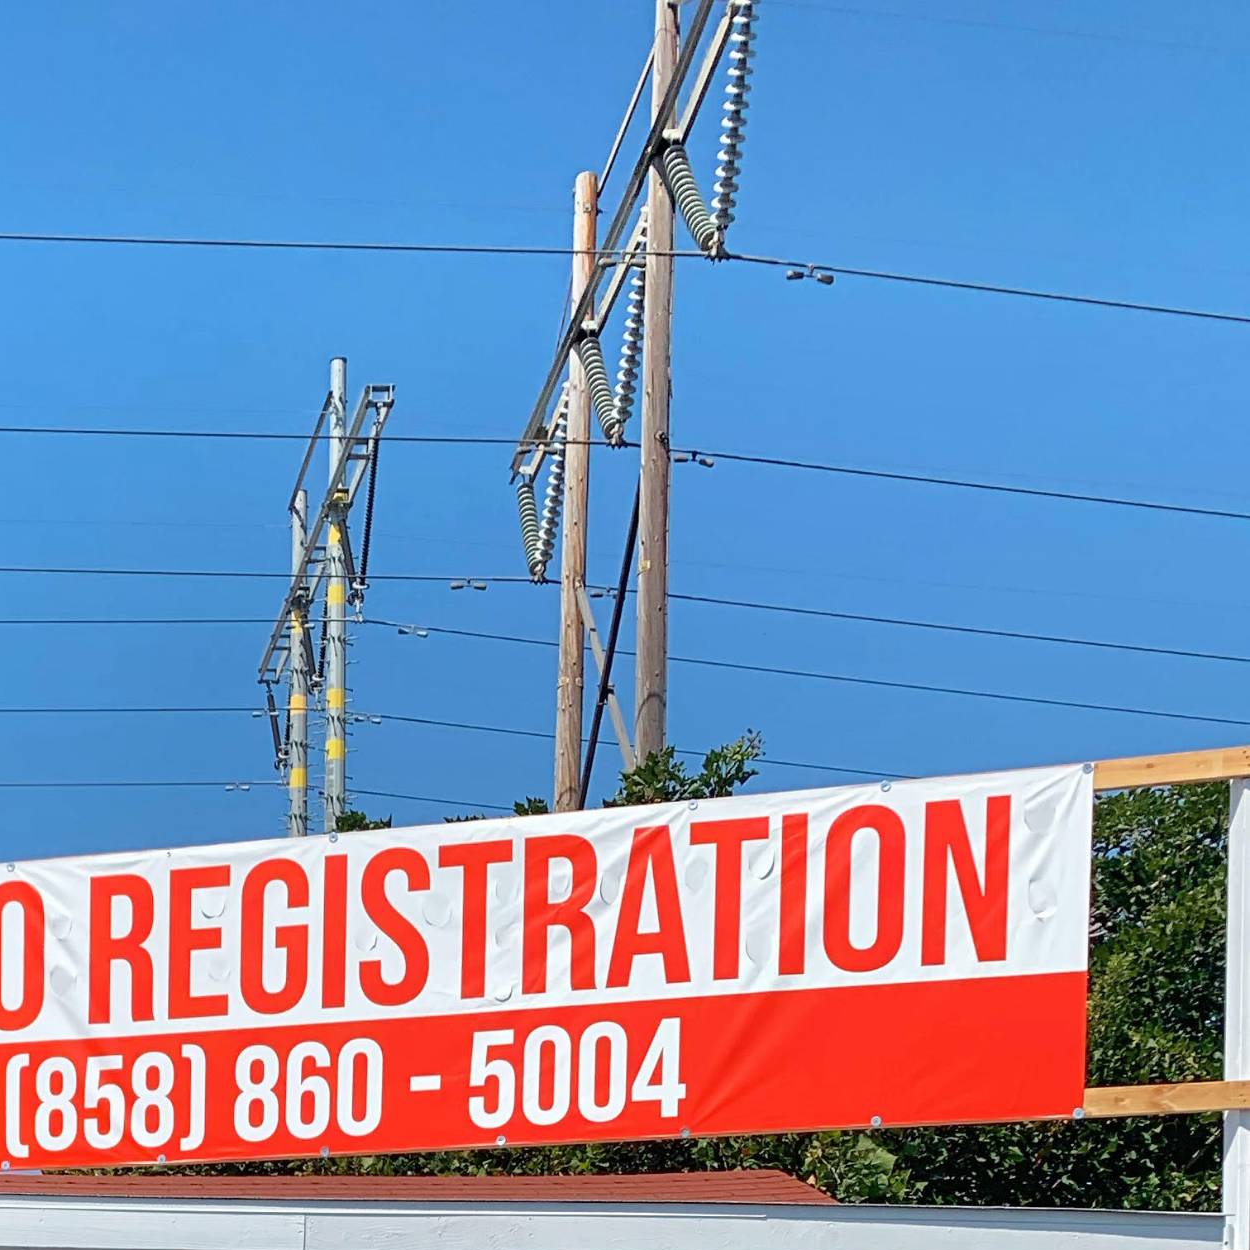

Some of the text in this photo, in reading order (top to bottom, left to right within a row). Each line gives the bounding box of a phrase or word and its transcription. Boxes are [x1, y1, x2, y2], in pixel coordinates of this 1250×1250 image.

[87, 794, 1012, 1025] REGISTRATION
[6, 1017, 686, 1157] (858) 860 - 5004
